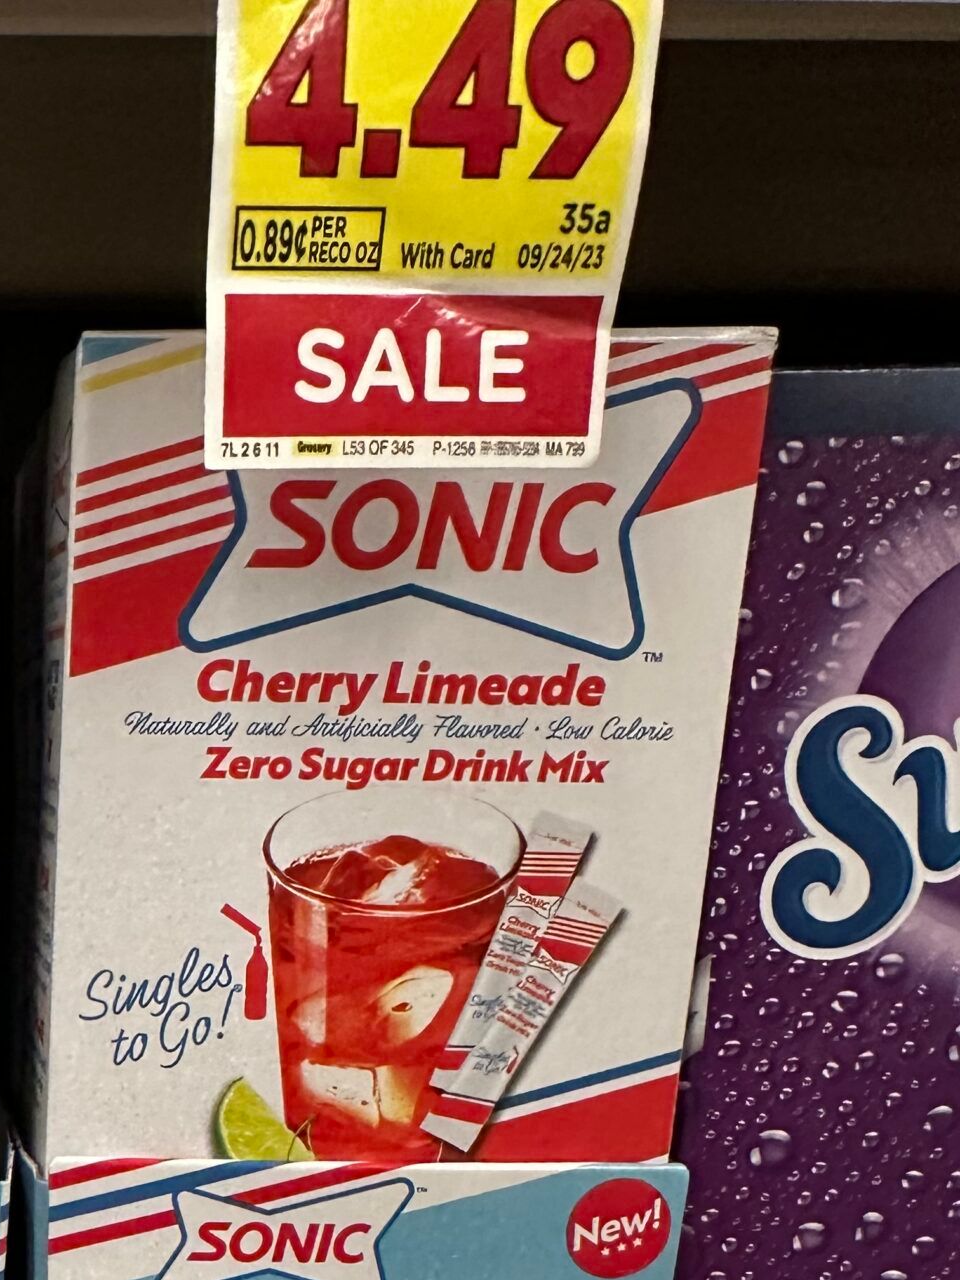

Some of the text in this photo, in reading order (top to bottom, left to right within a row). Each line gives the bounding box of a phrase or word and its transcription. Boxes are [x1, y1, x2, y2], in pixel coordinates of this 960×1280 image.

[246, 0, 634, 180] 4.49
[310, 216, 347, 239] PER
[559, 204, 610, 235] 35a
[308, 242, 378, 264] RECO OZ
[401, 242, 603, 271] With Card 09/24/23
[294, 328, 529, 403] SALE
[369, 441, 389, 455] OF
[391, 440, 414, 455] 345
[244, 480, 617, 573] SONIC
[197, 658, 606, 715] Cherry Limeade
[125, 711, 674, 743] Naturally and Artificially Flavored Low Calorie
[200, 746, 609, 790] Zero Sugar Drink Mix
[78, 947, 234, 1022] Singles
[111, 983, 243, 1068] to Go!
[187, 1222, 372, 1264] SONIC
[573, 1197, 662, 1252] New!
